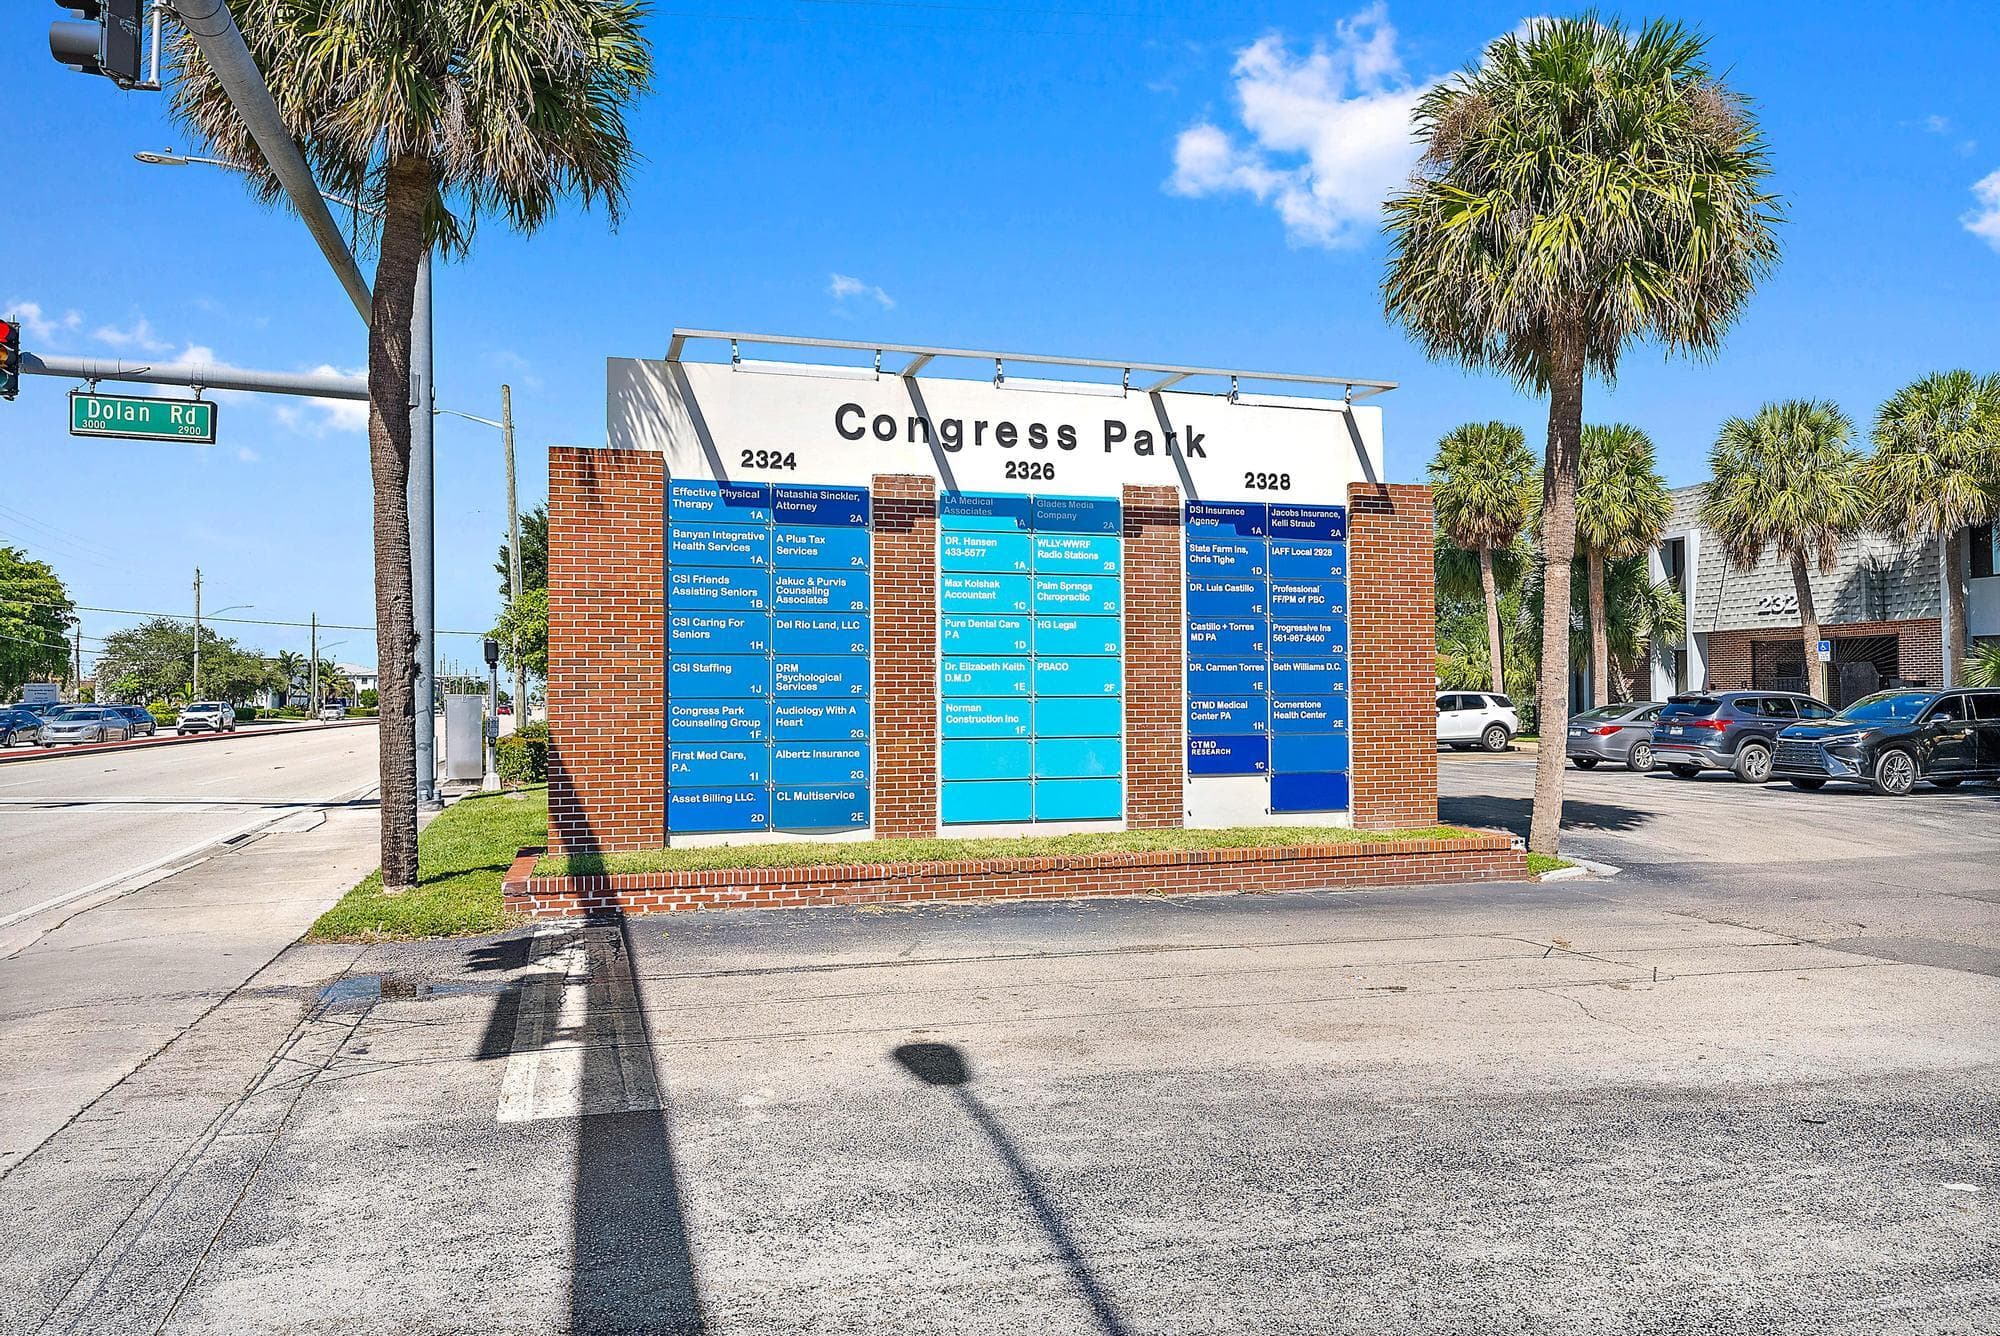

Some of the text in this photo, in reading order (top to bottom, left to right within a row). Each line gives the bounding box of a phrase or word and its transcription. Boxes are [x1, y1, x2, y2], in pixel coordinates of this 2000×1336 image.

[88, 400, 195, 424] Dolan Rd
[82, 420, 105, 428] 3000
[178, 426, 200, 435] 2900
[835, 402, 1207, 458] Congress Park
[741, 449, 797, 471] 2324
[1005, 461, 1055, 480] 2326
[1244, 471, 1291, 491] 2328
[673, 487, 760, 500] Effective Physical
[776, 490, 817, 499] Natashia
[673, 500, 713, 510] Therapy
[776, 502, 817, 512] Attorney
[1037, 500, 1094, 509] Glades Media
[944, 506, 992, 515] Associates
[1190, 506, 1244, 515] DSI Insurance
[1271, 509, 1340, 518] Jacobs Insurance,
[1037, 511, 1077, 520] Company
[1014, 519, 1025, 527] 1A
[1190, 517, 1219, 526] Agency
[673, 530, 765, 541] Banyan Integrative
[777, 535, 825, 544] A Plus Tax
[964, 538, 997, 546] Hansen
[673, 542, 750, 552] Health Services
[776, 547, 817, 555] Services
[751, 556, 763, 564] 1A
[1038, 551, 1098, 560] Radio Stations
[1215, 556, 1235, 565] Tighe
[1104, 562, 1115, 570] 2B
[673, 575, 730, 584] CSI Friends
[807, 578, 814, 586] &
[817, 578, 846, 587] Purvis
[945, 580, 962, 588] Max
[776, 587, 829, 596] Counseling
[1037, 582, 1092, 592] Palm Springs
[673, 588, 757, 598] Assisting Seniors
[945, 591, 996, 599] Accountant
[1037, 593, 1090, 602] Chiropractic
[776, 595, 828, 604] Associates
[1759, 593, 1800, 615] 232
[673, 618, 744, 628] CSI Caring For
[777, 621, 793, 629] Del
[795, 621, 810, 629] Rio
[813, 621, 839, 631] Land,
[945, 620, 1020, 629] Pure Dental Care
[1054, 622, 1076, 630] Legal
[1229, 623, 1254, 631] Torres
[1273, 624, 1318, 633] Progressive
[673, 630, 710, 638] Seniors
[673, 664, 732, 674] CSI Staffing
[776, 664, 798, 672] DRM
[945, 663, 1025, 671] Dr. Elizabeth Keith
[1293, 663, 1324, 671] Williams
[776, 673, 842, 683] Psychological
[776, 683, 817, 691] Services
[851, 685, 862, 693] 2F
[1191, 701, 1248, 709] CTMD Medical
[672, 707, 744, 717] Congress Park
[776, 707, 823, 717] Audiology
[1191, 712, 1218, 720] Center
[672, 718, 760, 729] Counseling Group
[776, 718, 803, 726] Heart
[946, 715, 1018, 723] Construction Inc
[672, 752, 695, 760] First
[723, 751, 746, 761] Care,
[813, 750, 859, 758] Insurance
[672, 764, 690, 772] P.A.
[851, 771, 864, 779] 2G
[672, 795, 700, 803] Asset
[702, 795, 733, 804] Billing
[777, 791, 855, 800] CL Multiservice
